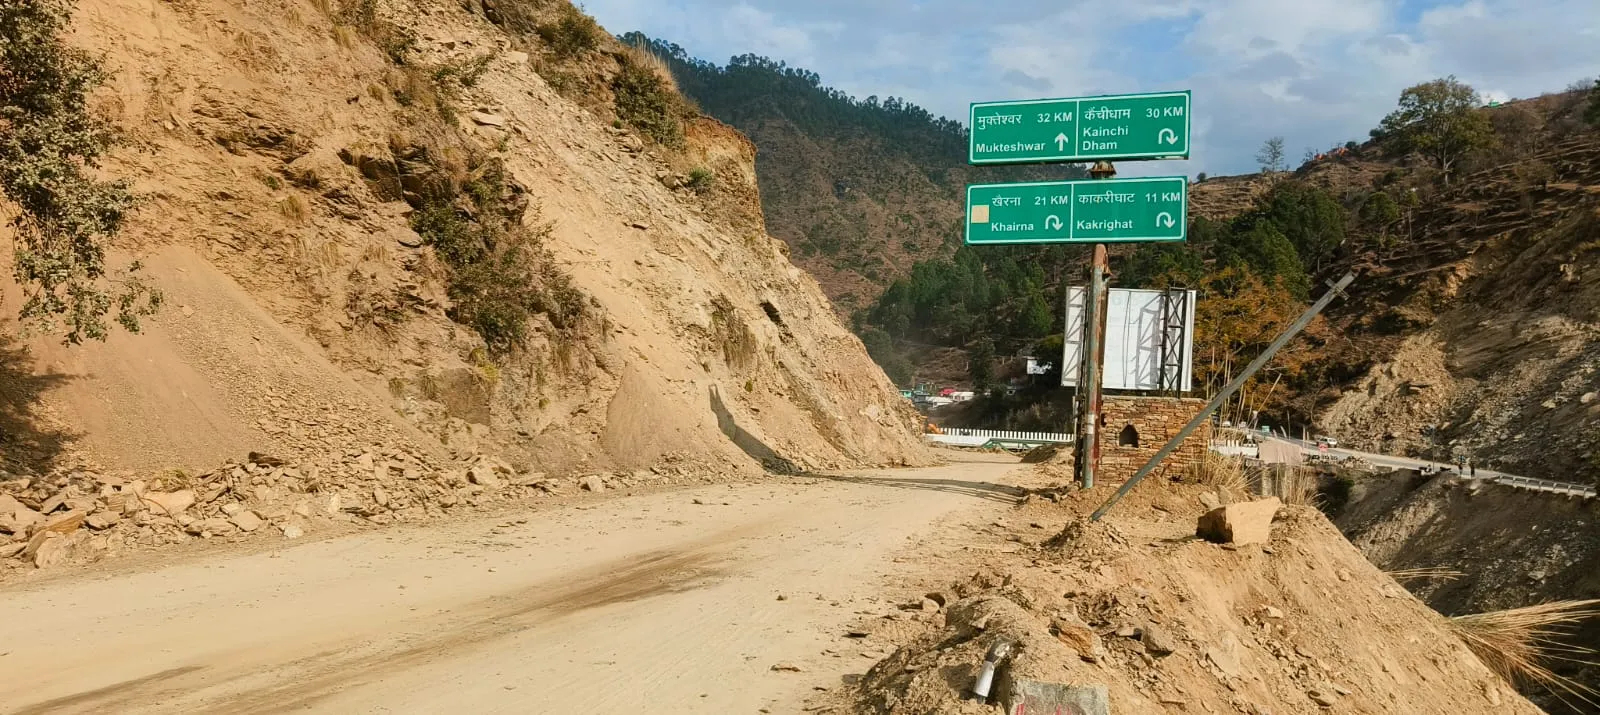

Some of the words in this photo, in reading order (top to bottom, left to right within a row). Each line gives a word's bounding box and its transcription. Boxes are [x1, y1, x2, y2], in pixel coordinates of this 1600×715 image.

[1146, 108, 1160, 119] 30
[1163, 106, 1184, 117] KM
[976, 112, 1022, 130] मुक्तेश्वर
[1037, 113, 1051, 123] 32
[1054, 111, 1073, 122] KM
[1083, 125, 1129, 137] Kainchi
[975, 140, 1046, 153] Mukteshwar
[1082, 140, 1117, 151] Dham
[991, 194, 1021, 207] खैरना
[1034, 196, 1046, 206] 21
[1050, 195, 1068, 205] KM
[1078, 190, 1135, 204] काकरीघाट
[1145, 193, 1157, 203] 11
[1161, 192, 1181, 202] KM
[991, 222, 1034, 232] Khairna
[1076, 219, 1133, 232] Kakrighat
